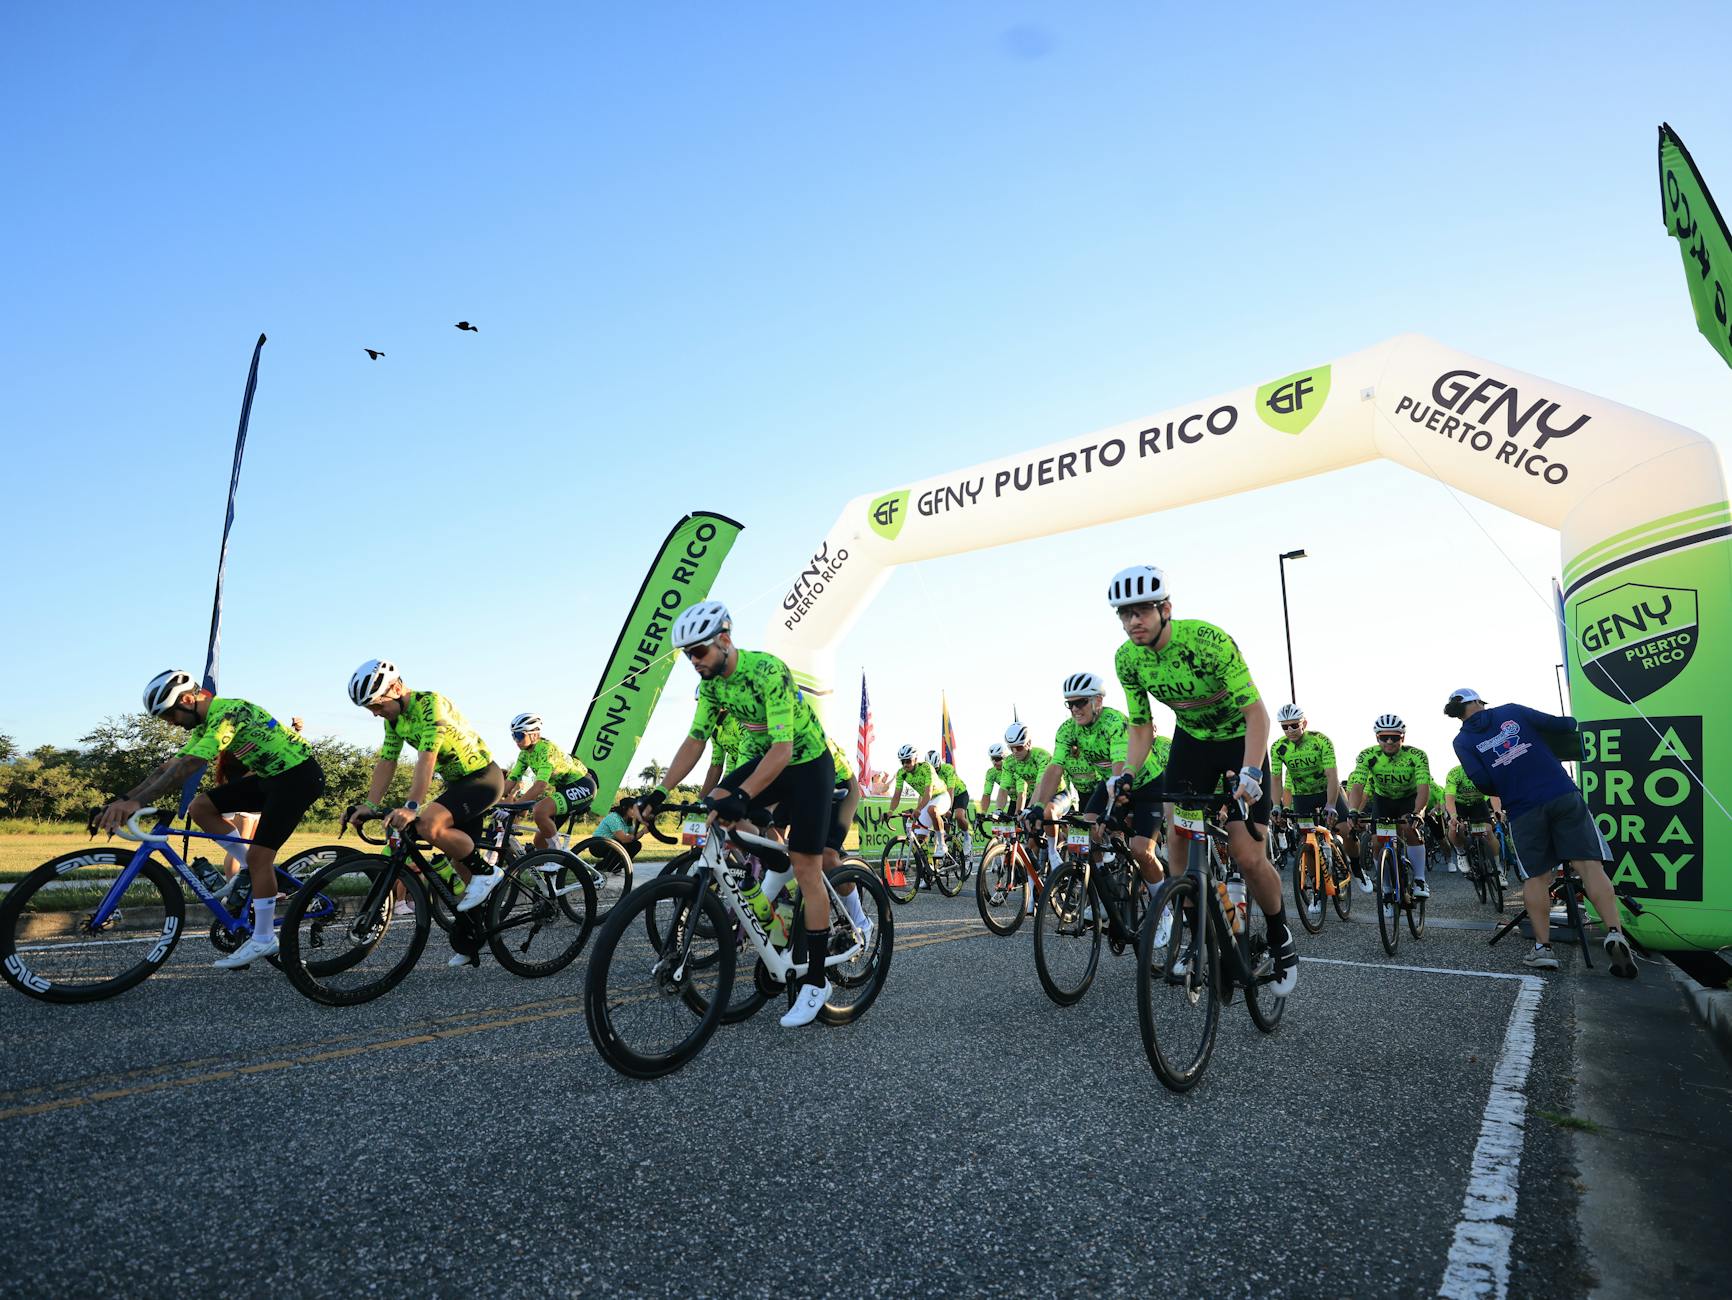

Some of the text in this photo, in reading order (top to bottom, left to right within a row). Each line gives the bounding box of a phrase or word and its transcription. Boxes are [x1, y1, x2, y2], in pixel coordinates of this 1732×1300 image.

[1265, 376, 1315, 415] GF
[1432, 370, 1592, 450] GFNY
[1395, 395, 1569, 485] PUERTO RICO
[917, 405, 1239, 517] GFNY PUERTO RICO
[873, 498, 900, 527] GF
[783, 541, 830, 611] GFNY
[784, 548, 849, 631] PUERTO RICO
[1197, 625, 1228, 644] GFNY
[1582, 594, 1673, 652] GFNY
[592, 523, 717, 763] GFNY PUERTO RICO
[1625, 632, 1691, 662] PUERTO
[1641, 648, 1685, 670] RICO
[1147, 681, 1195, 698] GFNY
[1582, 725, 1693, 763] BE A
[1287, 756, 1317, 769] GFNY
[1375, 773, 1413, 784] GFNY
[565, 785, 591, 801] GFNY
[1583, 768, 1691, 807] PRO
[689, 823, 700, 833] 42
[865, 833, 890, 847] RICO
[1072, 836, 1085, 844] 174
[1181, 819, 1194, 828] 37
[1595, 812, 1695, 845] OR A
[1612, 850, 1695, 891] AY
[722, 872, 769, 946] ORBEA
